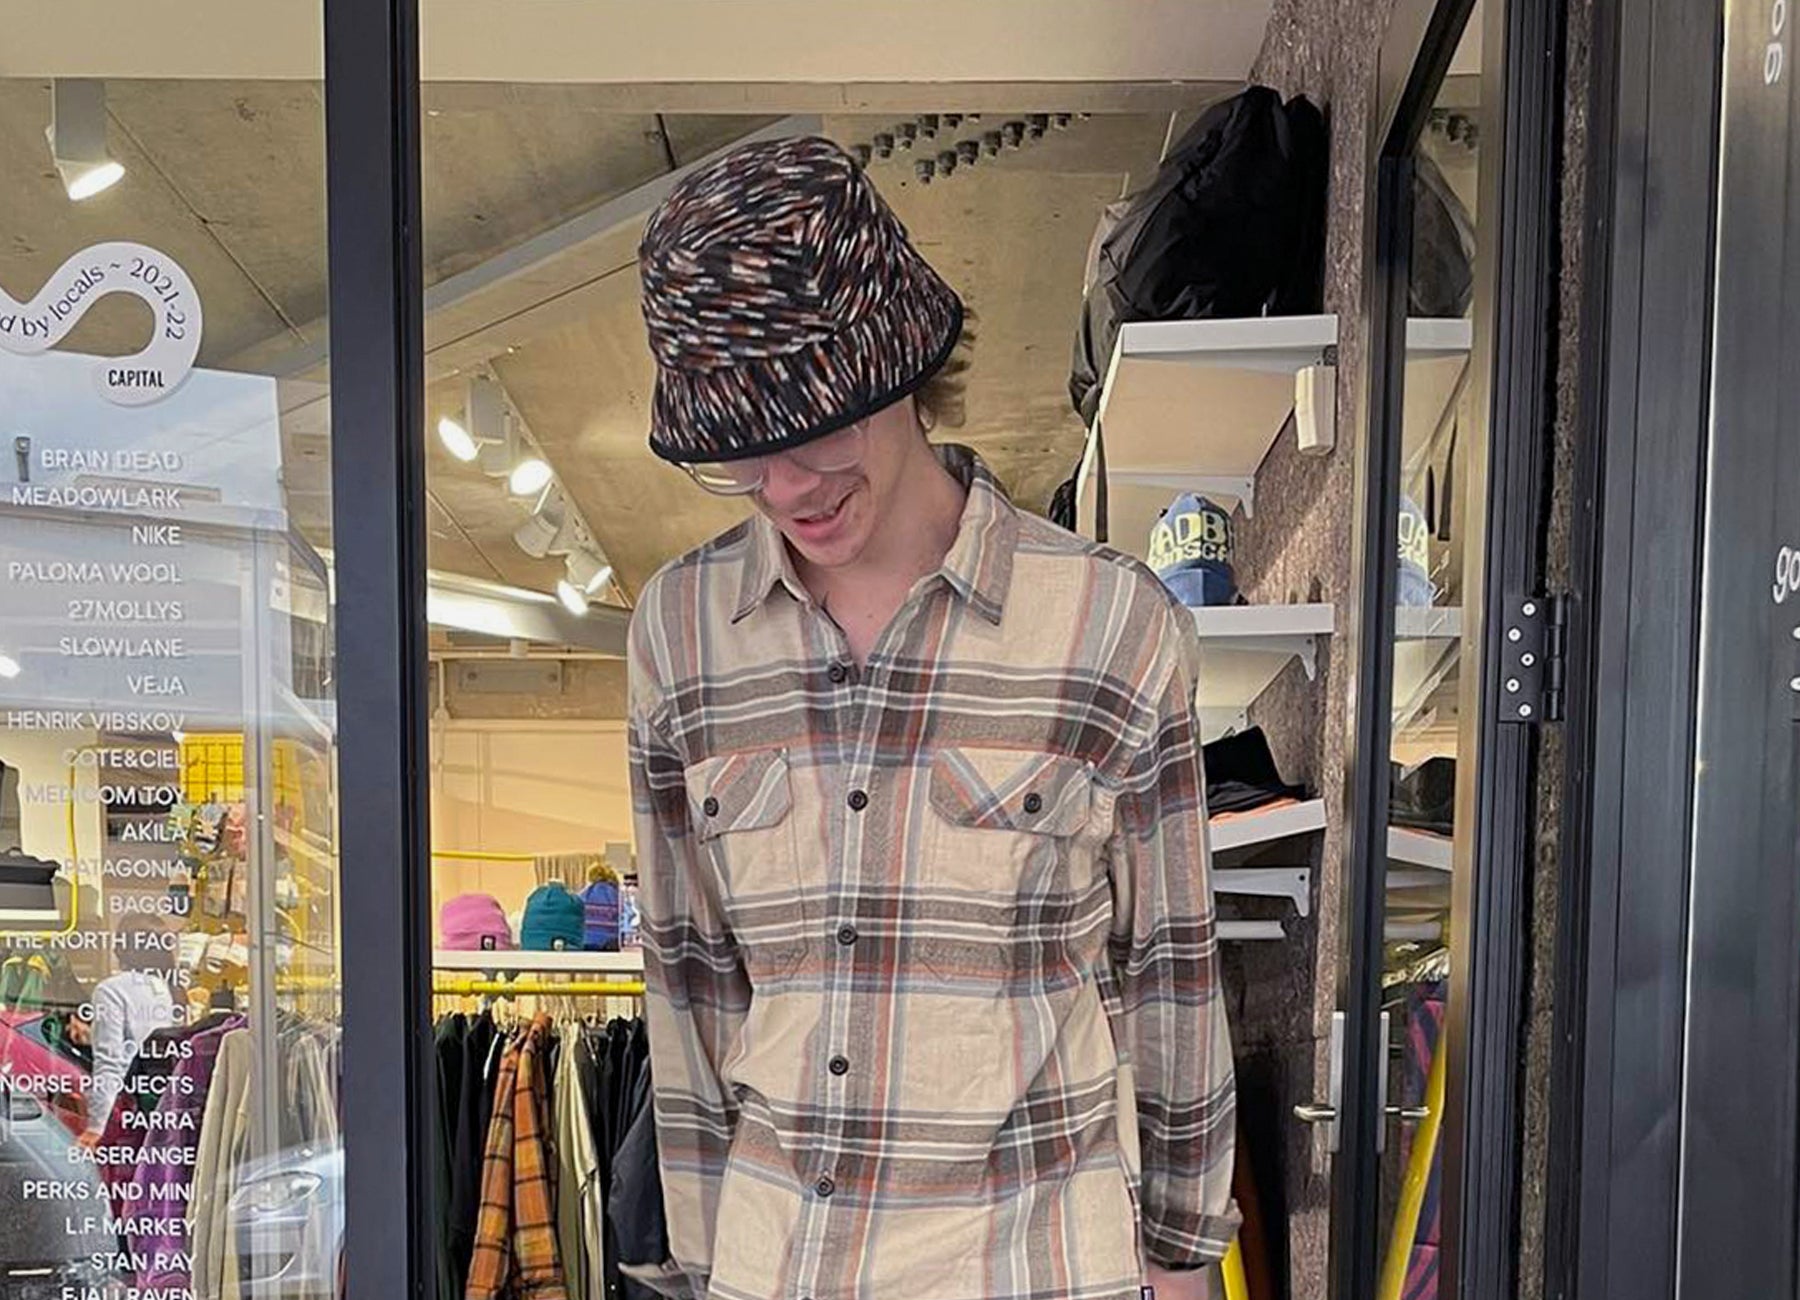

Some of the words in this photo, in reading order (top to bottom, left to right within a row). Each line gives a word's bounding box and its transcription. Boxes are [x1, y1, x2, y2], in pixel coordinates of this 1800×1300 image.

[21, 313, 50, 338] by
[47, 265, 105, 324] locals
[129, 257, 187, 341] 2021-22
[108, 369, 165, 388] CAPITAL
[41, 450, 108, 470] BRAIN
[116, 451, 182, 471] DEAD
[12, 487, 182, 508] MEADOWLARK
[132, 526, 182, 546] NIKE
[8, 562, 104, 582] PALOMA
[110, 563, 182, 583] WOOL
[68, 600, 183, 620] 27MOLLYS
[59, 637, 183, 657] SLOWLANE
[127, 675, 184, 695] VEJA
[7, 711, 84, 731] HENRIK
[90, 713, 185, 732] VIBSKOV
[121, 823, 188, 842] AKILA
[64, 859, 188, 879] PATAGONIA
[110, 897, 189, 917] BAGGU
[51, 931, 127, 950] NORTH
[0, 1074, 72, 1094] NORSE
[79, 1075, 194, 1095] PROJECTS
[122, 1112, 195, 1130] PARRA
[67, 1147, 195, 1166] BASERANGE
[23, 1181, 89, 1200] PERKS
[95, 1181, 143, 1199] AND
[66, 1217, 96, 1235] L.F
[103, 1218, 196, 1236] MARKEY
[91, 1252, 148, 1271] STAN
[155, 1253, 197, 1272] RAY
